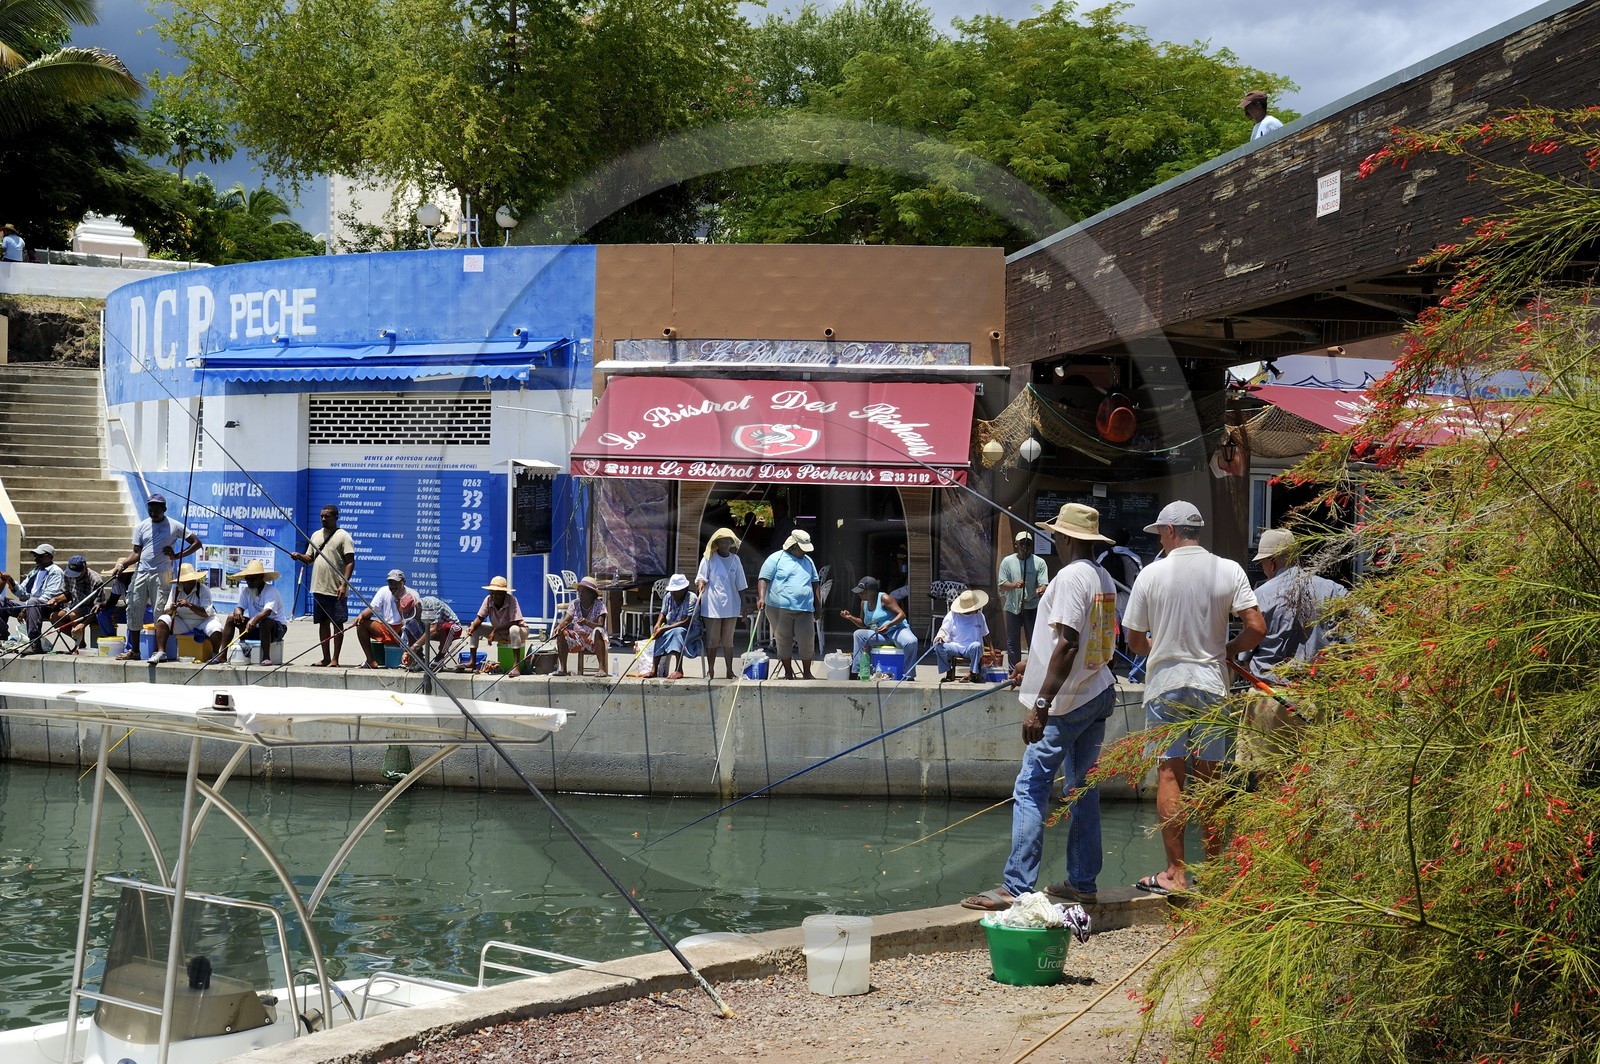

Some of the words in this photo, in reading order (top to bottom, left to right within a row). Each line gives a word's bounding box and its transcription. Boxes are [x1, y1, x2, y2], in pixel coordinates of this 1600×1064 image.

[1320, 176, 1338, 189] VITESSE
[230, 288, 316, 340] PECHE
[700, 340, 733, 362] Le
[734, 340, 806, 364] Bistrot
[598, 430, 646, 450] Le
[643, 394, 754, 428] Bistrot
[770, 390, 838, 414] Des
[848, 402, 937, 457] Pêcheurs
[619, 464, 629, 475] 33
[632, 464, 641, 476] 21
[643, 465, 654, 476] 02
[657, 460, 684, 476] Le
[688, 461, 756, 478] Bistrot
[758, 463, 793, 479] Des
[796, 464, 876, 482] Pêcheurs
[894, 472, 905, 482] 33
[908, 472, 917, 482] 21
[920, 473, 930, 483] 02
[212, 482, 246, 496] OUVERT
[247, 483, 263, 497] LES
[462, 479, 481, 487] 0262
[462, 490, 483, 508] 33
[181, 505, 218, 518] MERCREDI
[221, 506, 250, 519] SAMEDI
[251, 506, 293, 520] DIMANCHE
[460, 512, 483, 530] 33
[459, 536, 482, 553] 99
